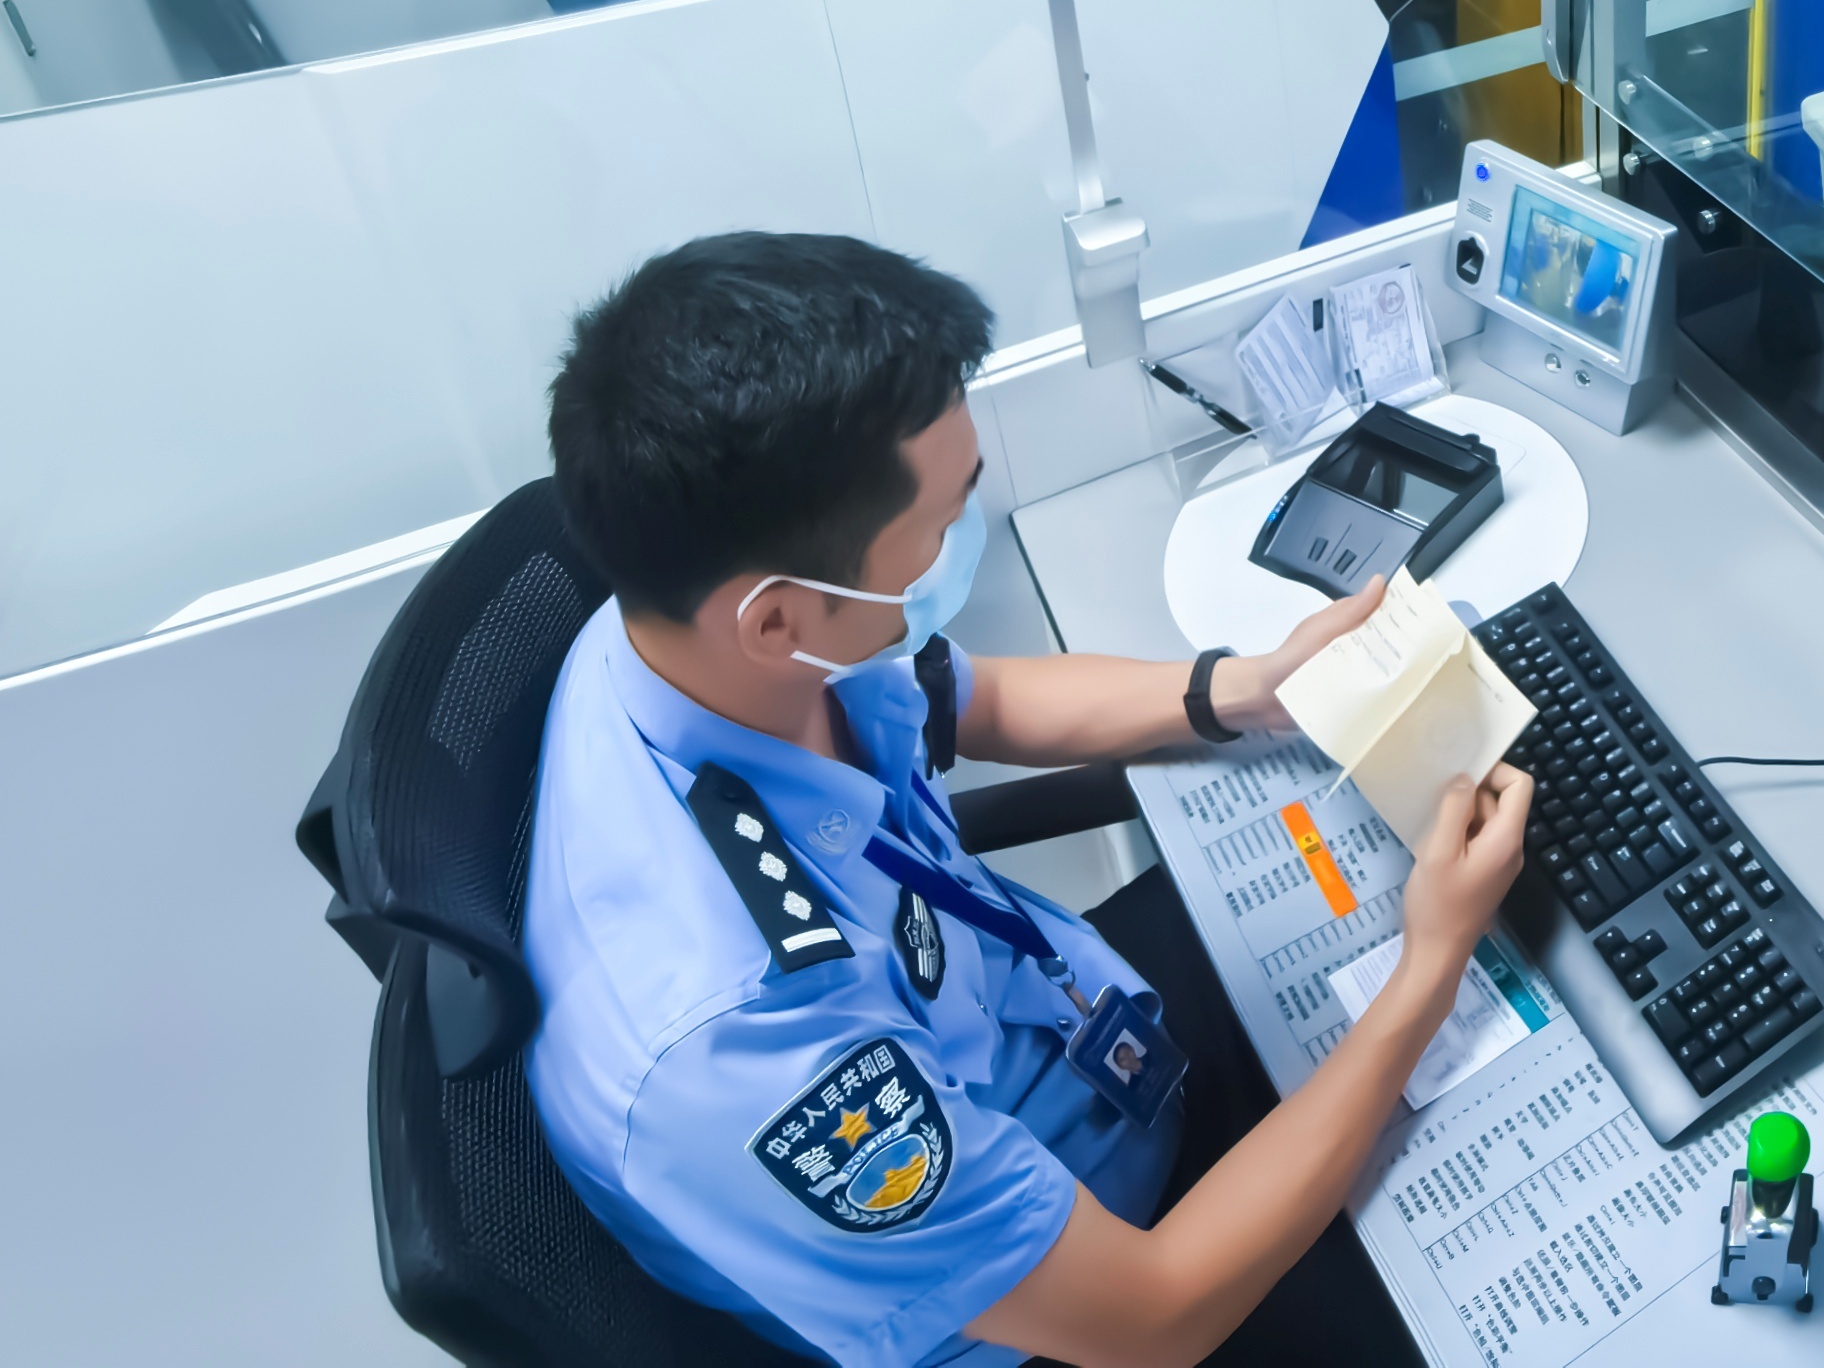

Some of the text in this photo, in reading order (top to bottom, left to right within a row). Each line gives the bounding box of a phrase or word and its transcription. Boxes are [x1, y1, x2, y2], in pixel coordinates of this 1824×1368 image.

[766, 1043, 897, 1160] 中华人民共和国
